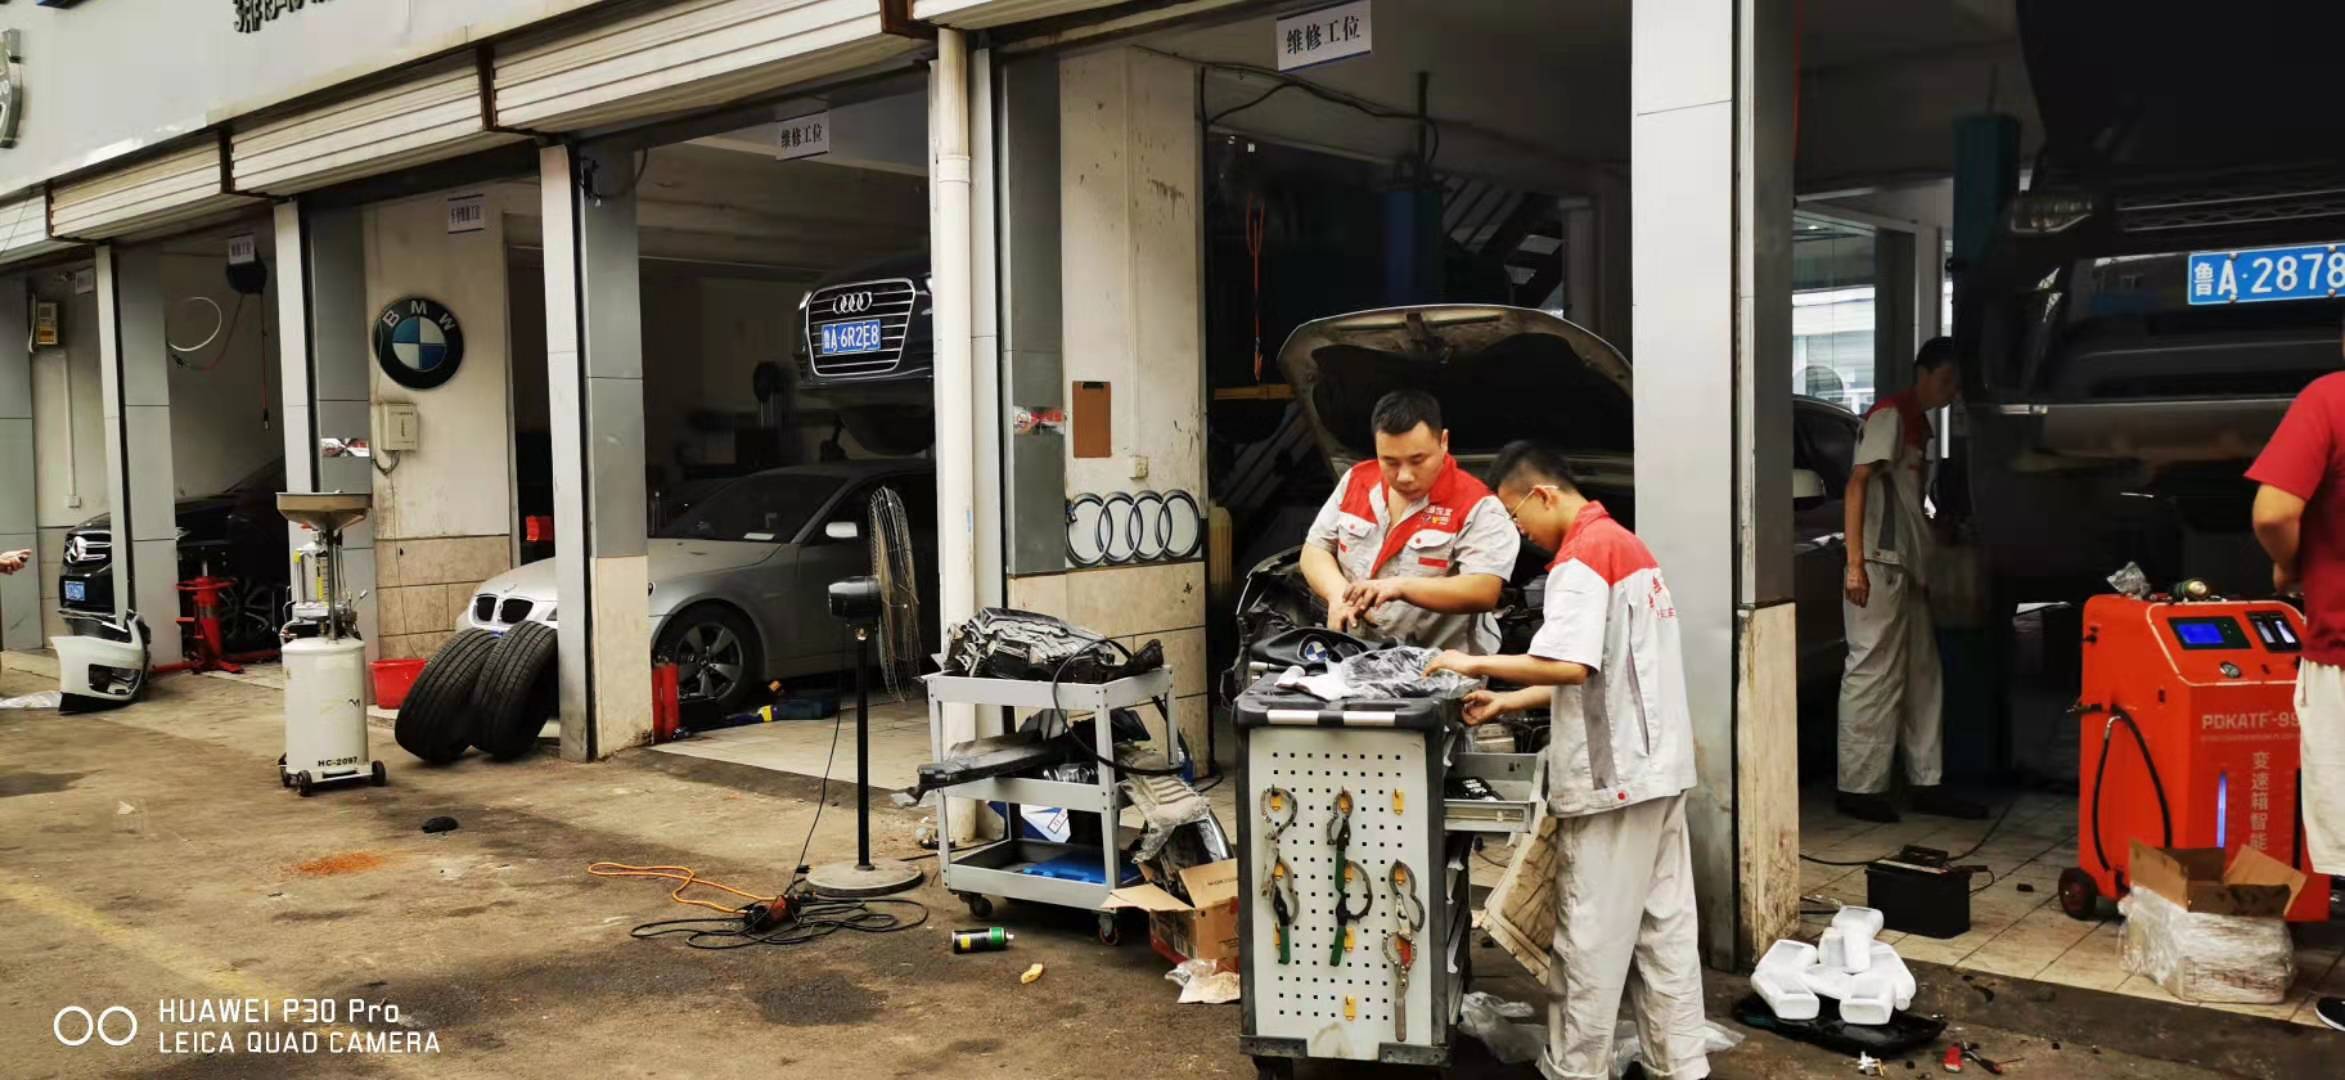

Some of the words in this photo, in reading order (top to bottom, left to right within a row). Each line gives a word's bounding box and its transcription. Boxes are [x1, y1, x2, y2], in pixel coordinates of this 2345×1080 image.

[1286, 15, 1361, 55] 维修工位
[382, 300, 456, 331] BMW
